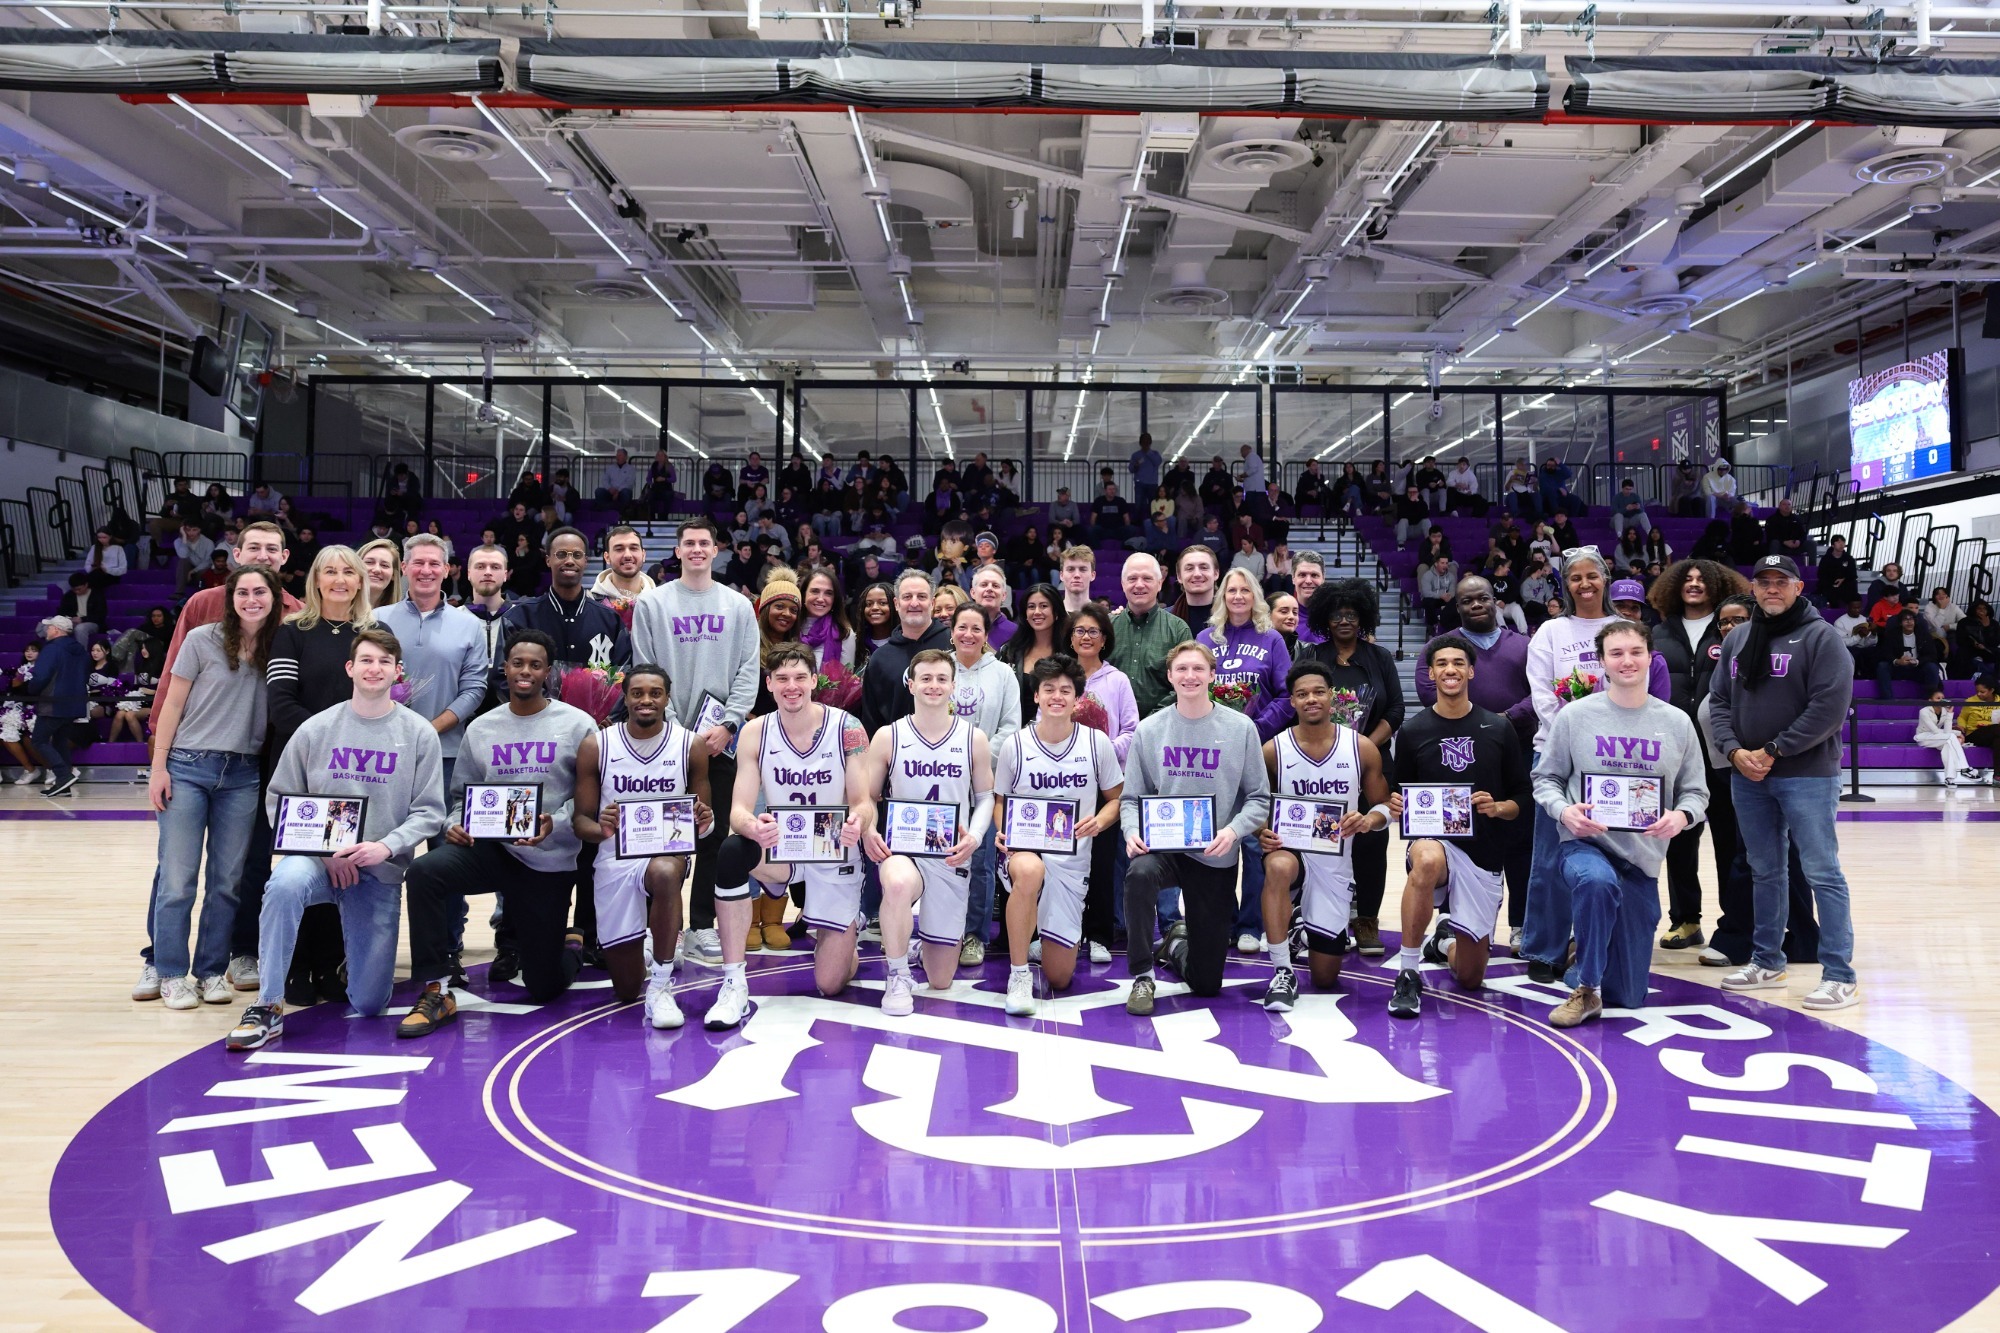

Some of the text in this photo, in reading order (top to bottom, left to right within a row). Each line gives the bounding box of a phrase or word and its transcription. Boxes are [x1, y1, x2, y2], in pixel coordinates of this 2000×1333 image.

[1851, 378, 1947, 427] SENIOR DAY
[1928, 449, 1938, 465] 0
[1862, 465, 1871, 479] 0
[1617, 584, 1641, 595] NYU
[671, 614, 725, 635] NYU
[679, 633, 719, 643] BASKETBALL
[1561, 640, 1592, 655] NEW
[1212, 643, 1268, 661] EW YORK
[1214, 671, 1260, 685] IVERSITY
[491, 741, 558, 767] NYU
[1162, 746, 1221, 770] NYU
[1594, 735, 1662, 762] NYU
[328, 747, 398, 774] NYU
[903, 760, 963, 779] Violets
[1600, 759, 1655, 772] BASKETBALL
[332, 771, 388, 785] BASKETBALL
[497, 765, 550, 776] BASKETBALL
[773, 767, 832, 787] Violets
[1167, 769, 1215, 779] BASKETBALL
[612, 774, 676, 794] Violets
[1028, 771, 1088, 791] Violets
[1291, 777, 1350, 797] Violets
[925, 784, 940, 801] 4
[1380, 952, 1932, 1306] VERSITY
[157, 1051, 578, 1316] NEW
